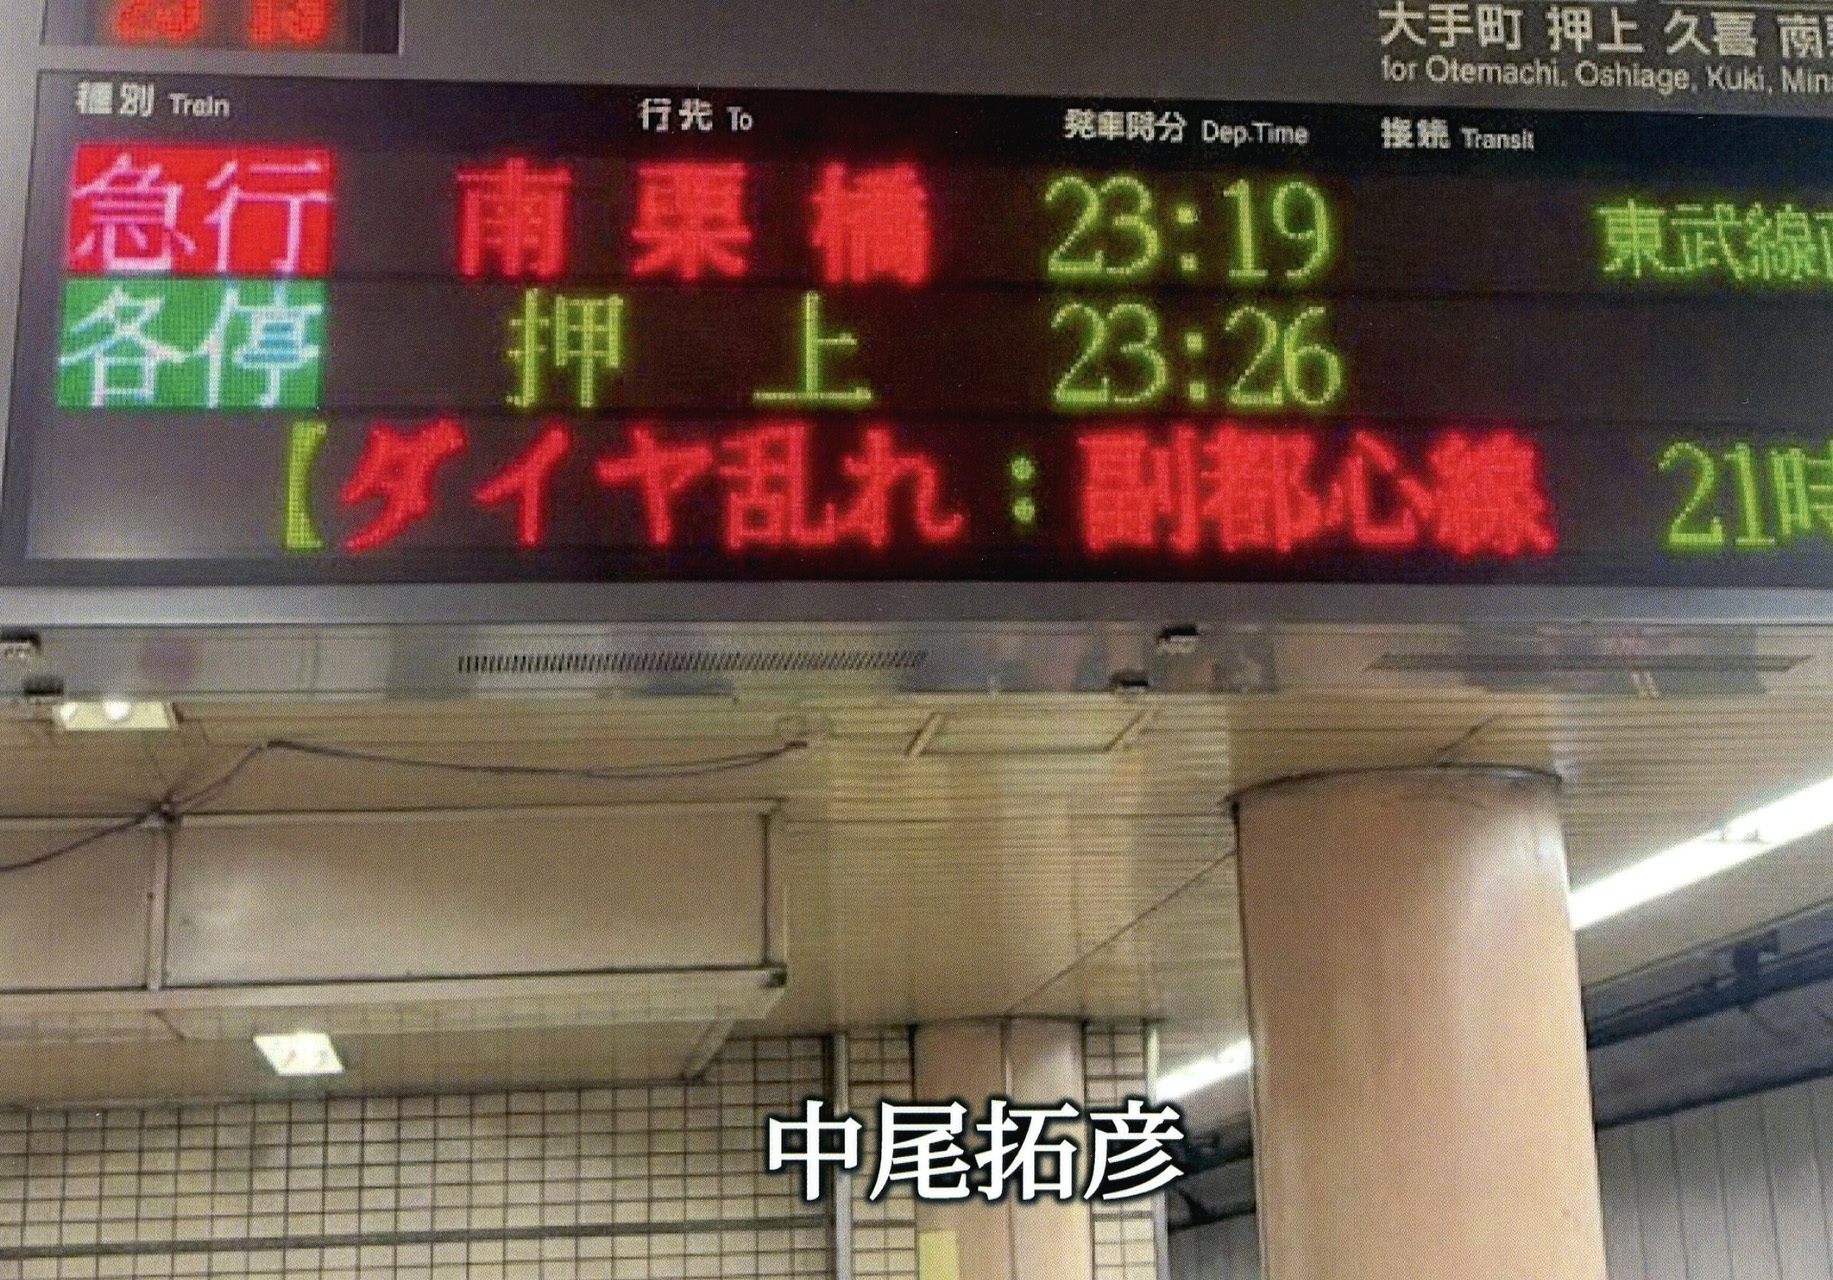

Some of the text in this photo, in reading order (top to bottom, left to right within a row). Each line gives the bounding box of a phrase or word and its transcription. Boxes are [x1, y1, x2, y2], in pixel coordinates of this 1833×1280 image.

[1378, 0, 1833, 59] 大手町 押上 久喜 南
[1381, 55, 1418, 82] for
[1781, 66, 1833, 93] Min
[169, 93, 230, 117] Train
[637, 98, 753, 132] 行先 To
[1459, 128, 1535, 151] Transit
[73, 152, 332, 274] 急行
[1045, 175, 1333, 280] 23:19
[1597, 198, 1833, 280] 東武線
[60, 285, 322, 407] 各停
[1050, 303, 1344, 407] 23:26
